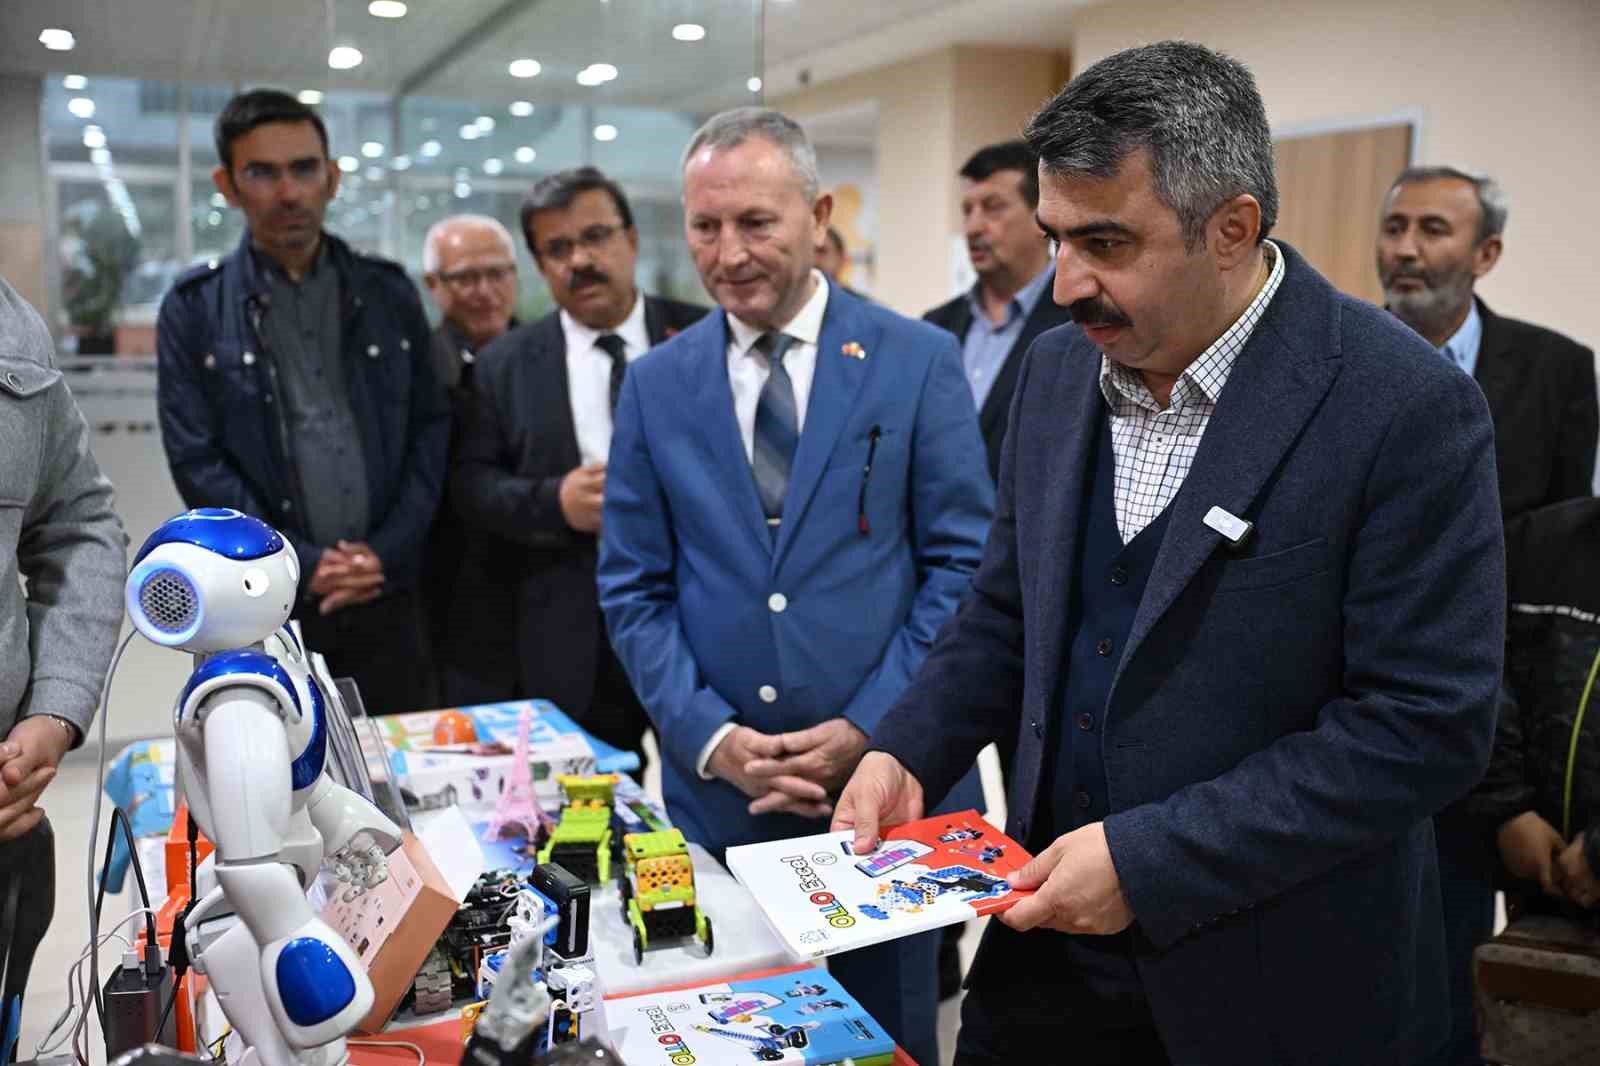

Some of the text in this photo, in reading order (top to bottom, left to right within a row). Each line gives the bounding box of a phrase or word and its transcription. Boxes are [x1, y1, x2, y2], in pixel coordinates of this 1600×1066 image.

[780, 855, 827, 893] Excel
[809, 891, 856, 928] OLLO
[658, 1034, 696, 1065] OLLO
